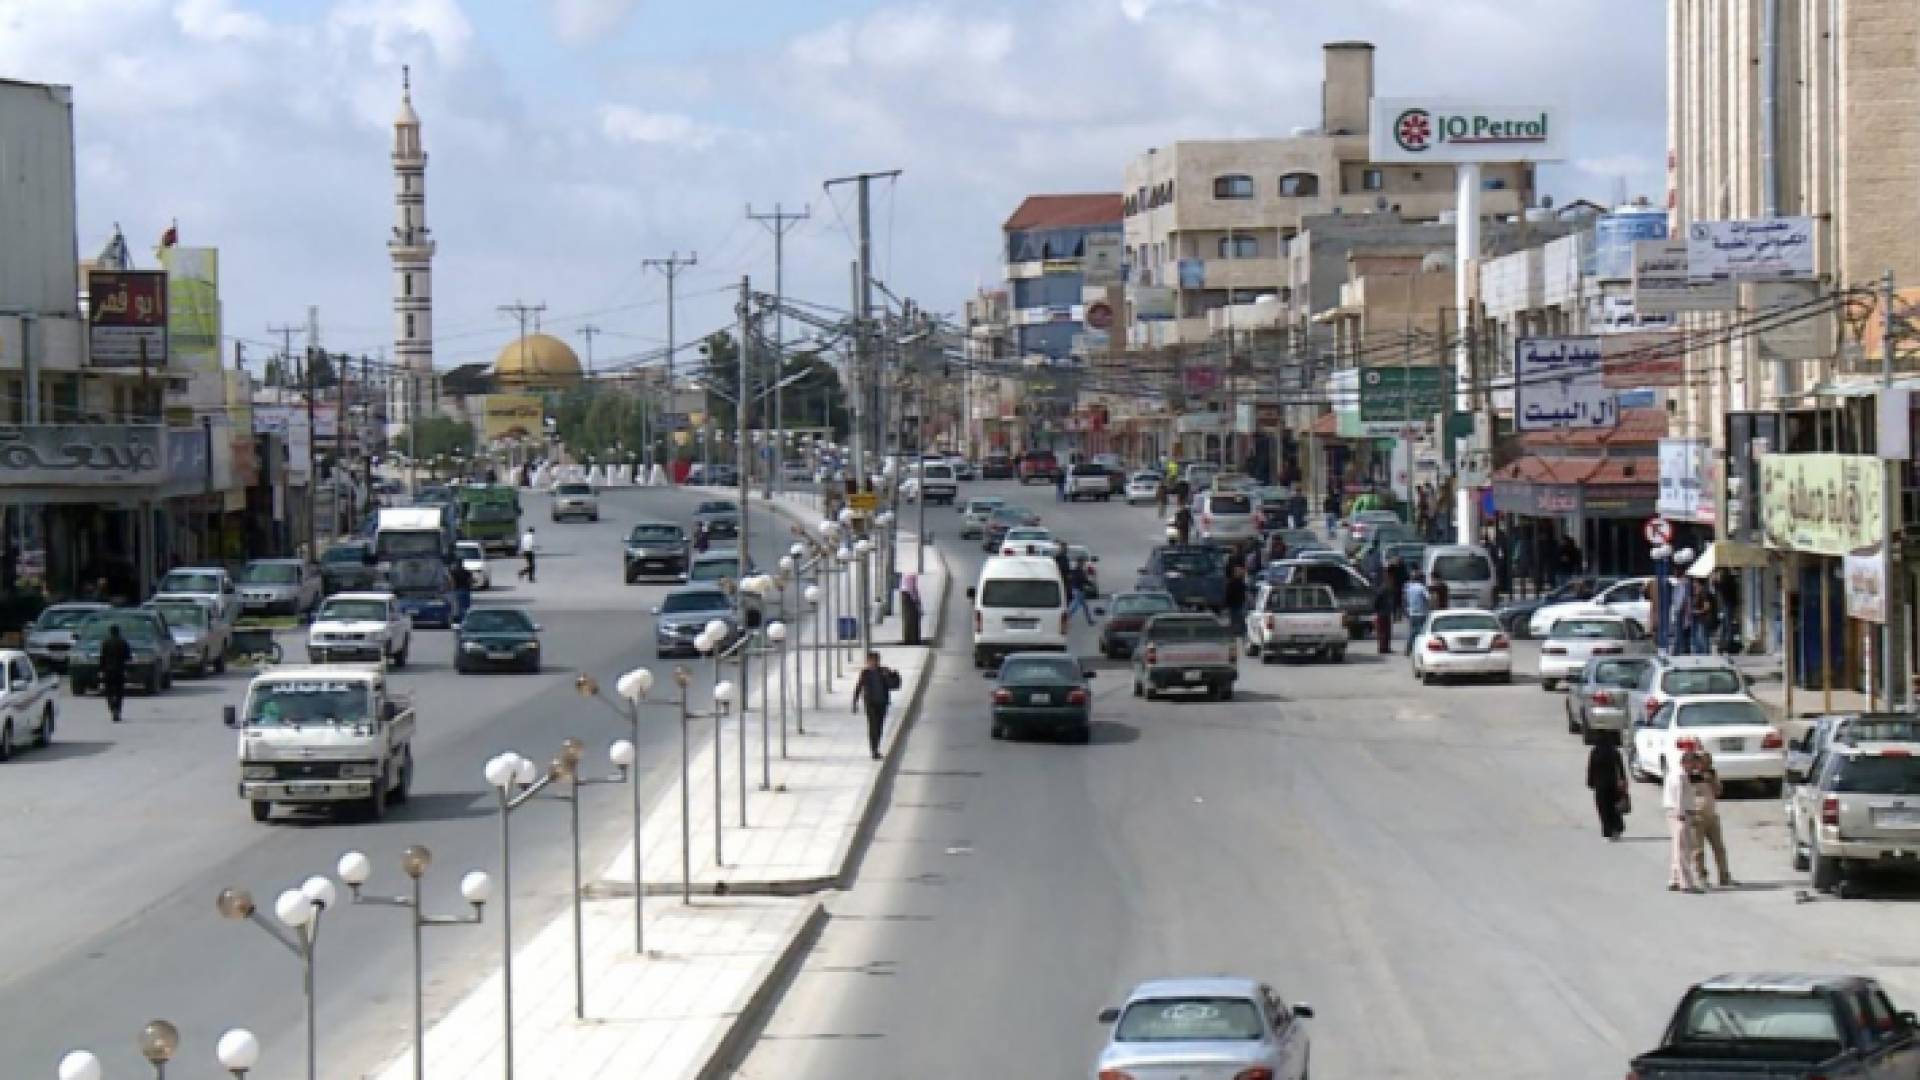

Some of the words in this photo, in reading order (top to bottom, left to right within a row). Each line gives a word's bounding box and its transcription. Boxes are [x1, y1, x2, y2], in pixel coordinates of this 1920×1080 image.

[1438, 115, 1468, 143] JO
[1473, 112, 1549, 137] Petrol
[1524, 400, 1588, 428] البيت
